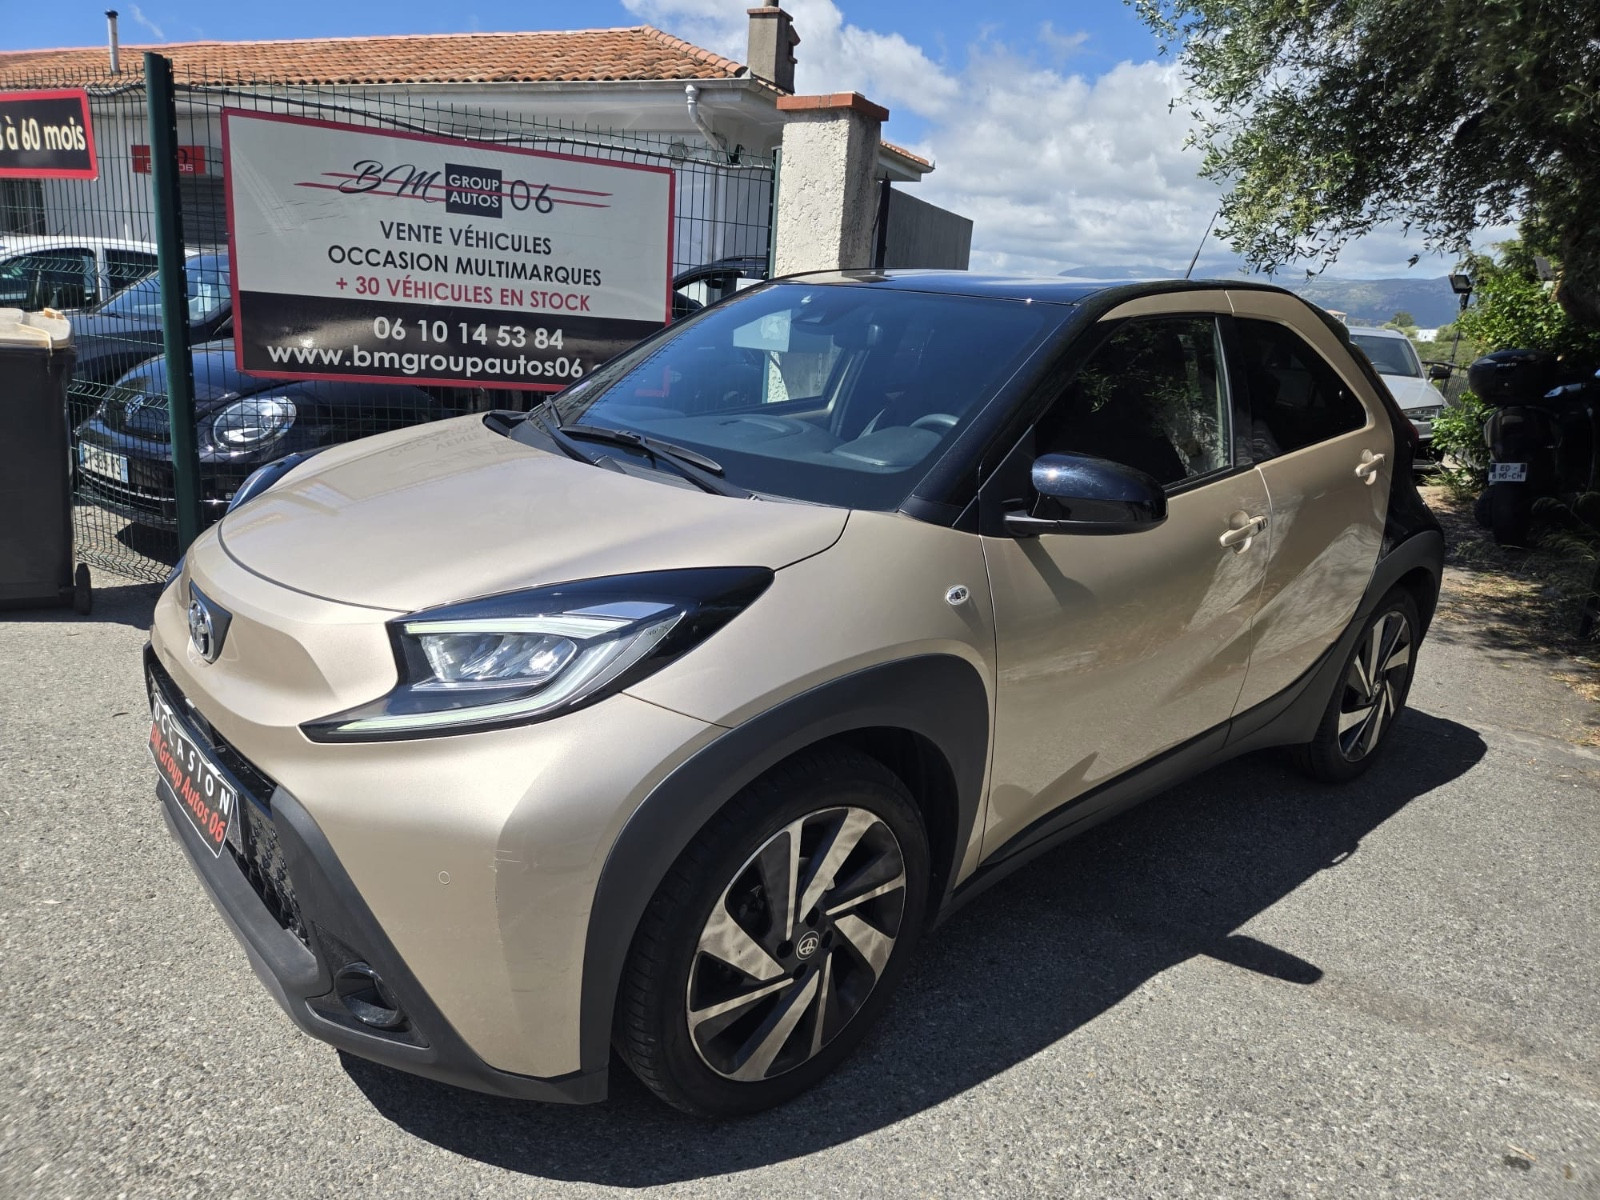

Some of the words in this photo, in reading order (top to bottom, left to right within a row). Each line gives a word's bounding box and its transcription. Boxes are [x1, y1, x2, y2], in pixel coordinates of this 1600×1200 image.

[4, 115, 19, 150] à
[21, 118, 41, 151] 60
[43, 116, 86, 151] mois
[338, 159, 442, 204] BM
[449, 174, 500, 192] GROUP
[509, 179, 554, 214] 06
[449, 191, 500, 208] AUTOS
[380, 220, 443, 245] VENTE
[449, 224, 552, 256] VÉHICULES
[328, 245, 448, 273] OCCASION
[455, 256, 602, 287] MULTIMARQUES
[336, 277, 348, 290] +
[355, 275, 380, 296] 30
[386, 274, 493, 305] VÉHICULES
[500, 288, 523, 306] EN
[530, 290, 591, 312] STOCK
[373, 316, 406, 341] 06
[417, 319, 448, 343] 10
[458, 322, 488, 346] 14
[496, 325, 526, 347] 53
[534, 327, 564, 350] 84
[267, 345, 602, 378] www.bmgroupautos06
[154, 702, 230, 816] OCCASION
[160, 741, 183, 790] Group
[181, 776, 210, 825] Autos
[208, 812, 226, 842] 06
